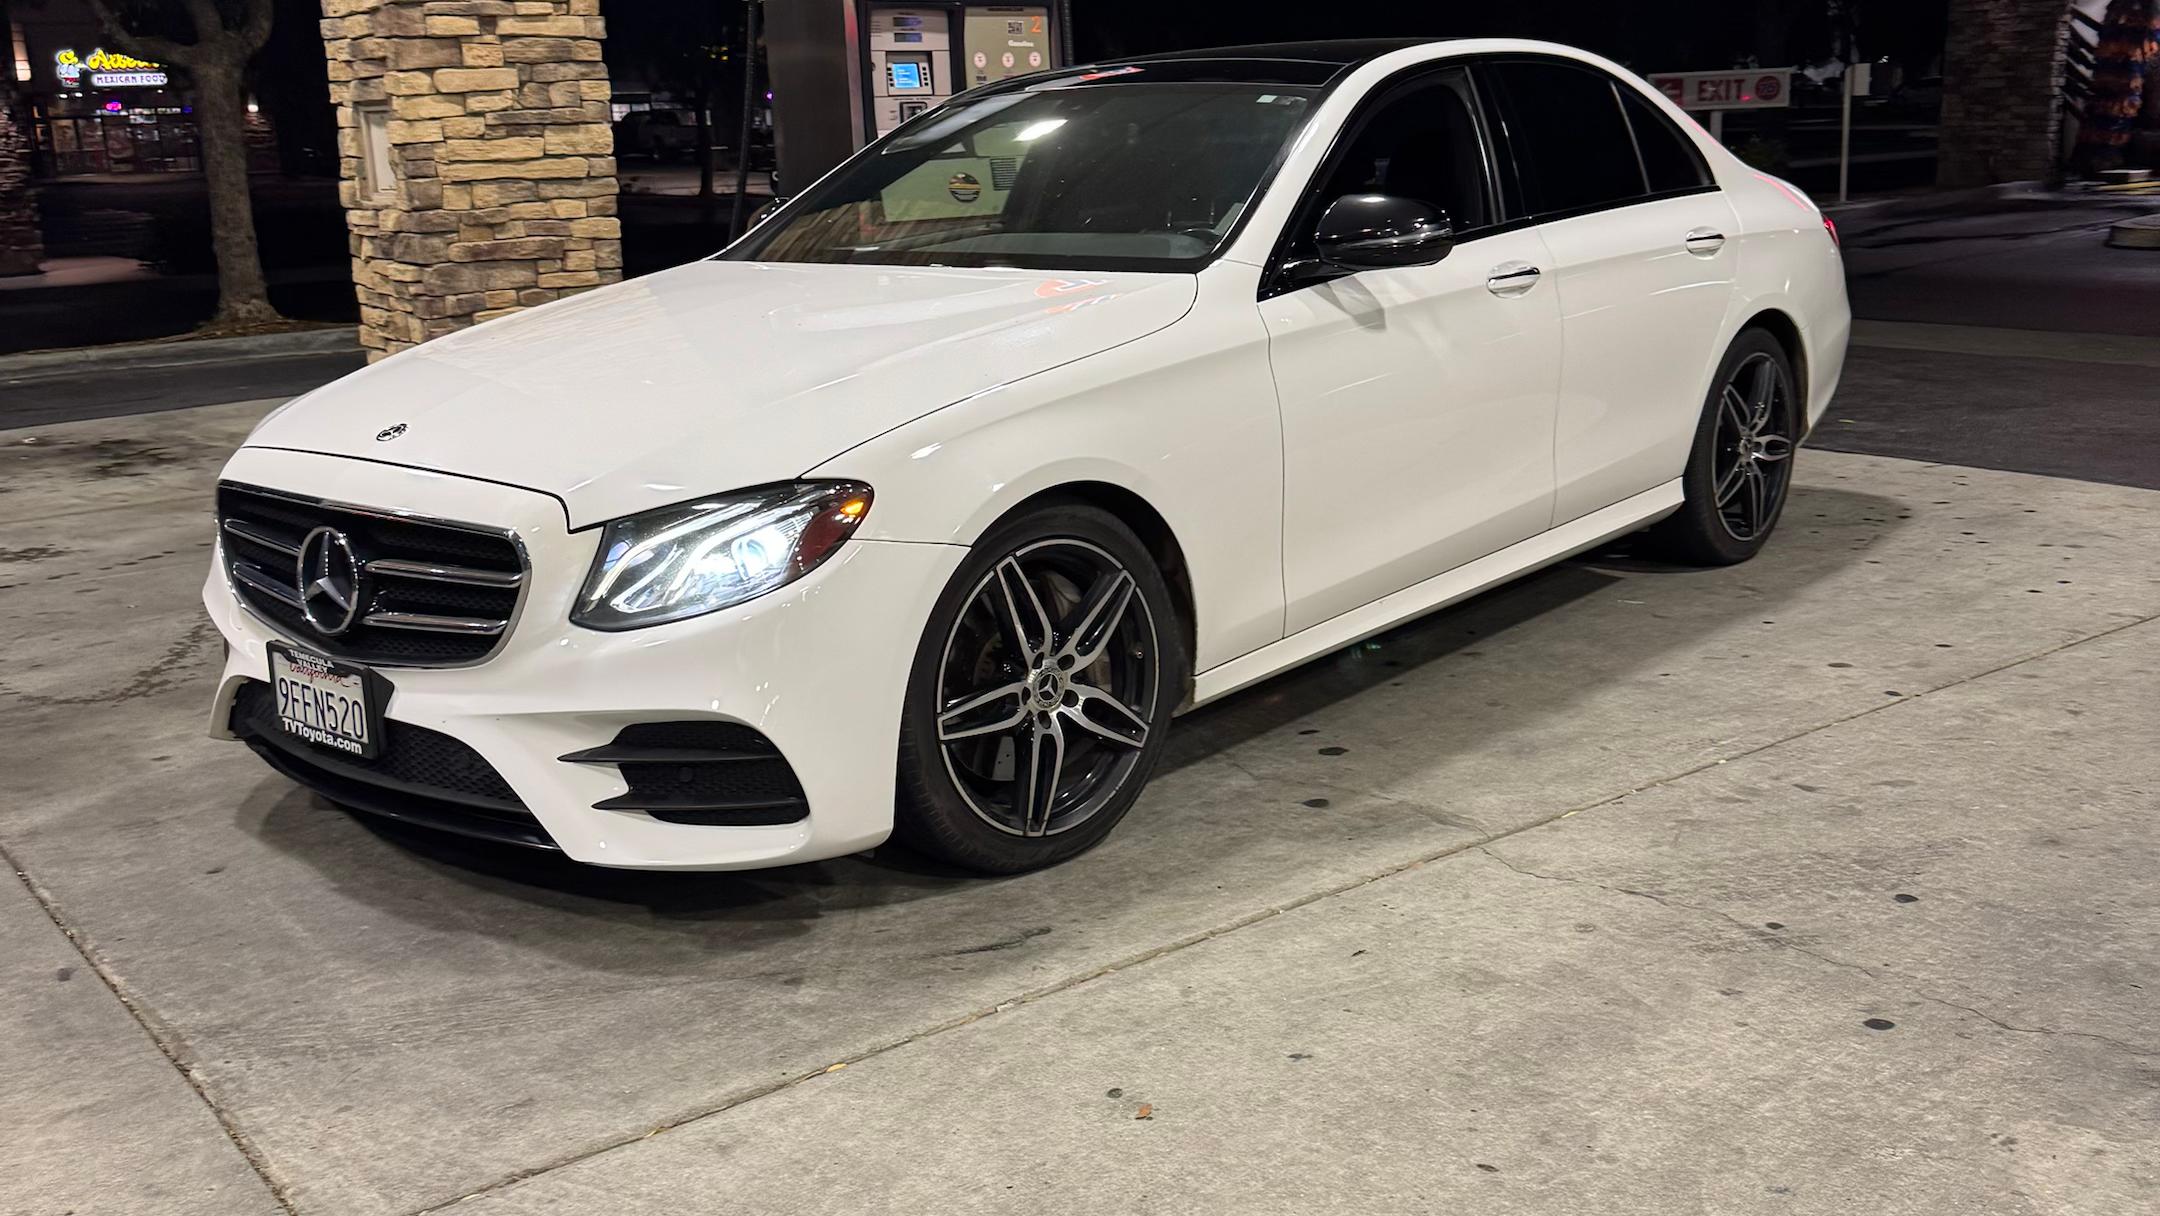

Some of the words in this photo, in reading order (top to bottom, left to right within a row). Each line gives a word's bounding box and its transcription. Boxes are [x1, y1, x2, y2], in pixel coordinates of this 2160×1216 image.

[1029, 15, 1042, 33] 2
[96, 75, 137, 84] MEXICAN
[140, 74, 166, 83] FOOD
[1698, 79, 1746, 102] EXIT
[288, 649, 335, 669] TEMECULA
[296, 659, 328, 673] VALLEY
[278, 677, 365, 740] 9FFN520
[282, 717, 363, 755] TVToyota.com
